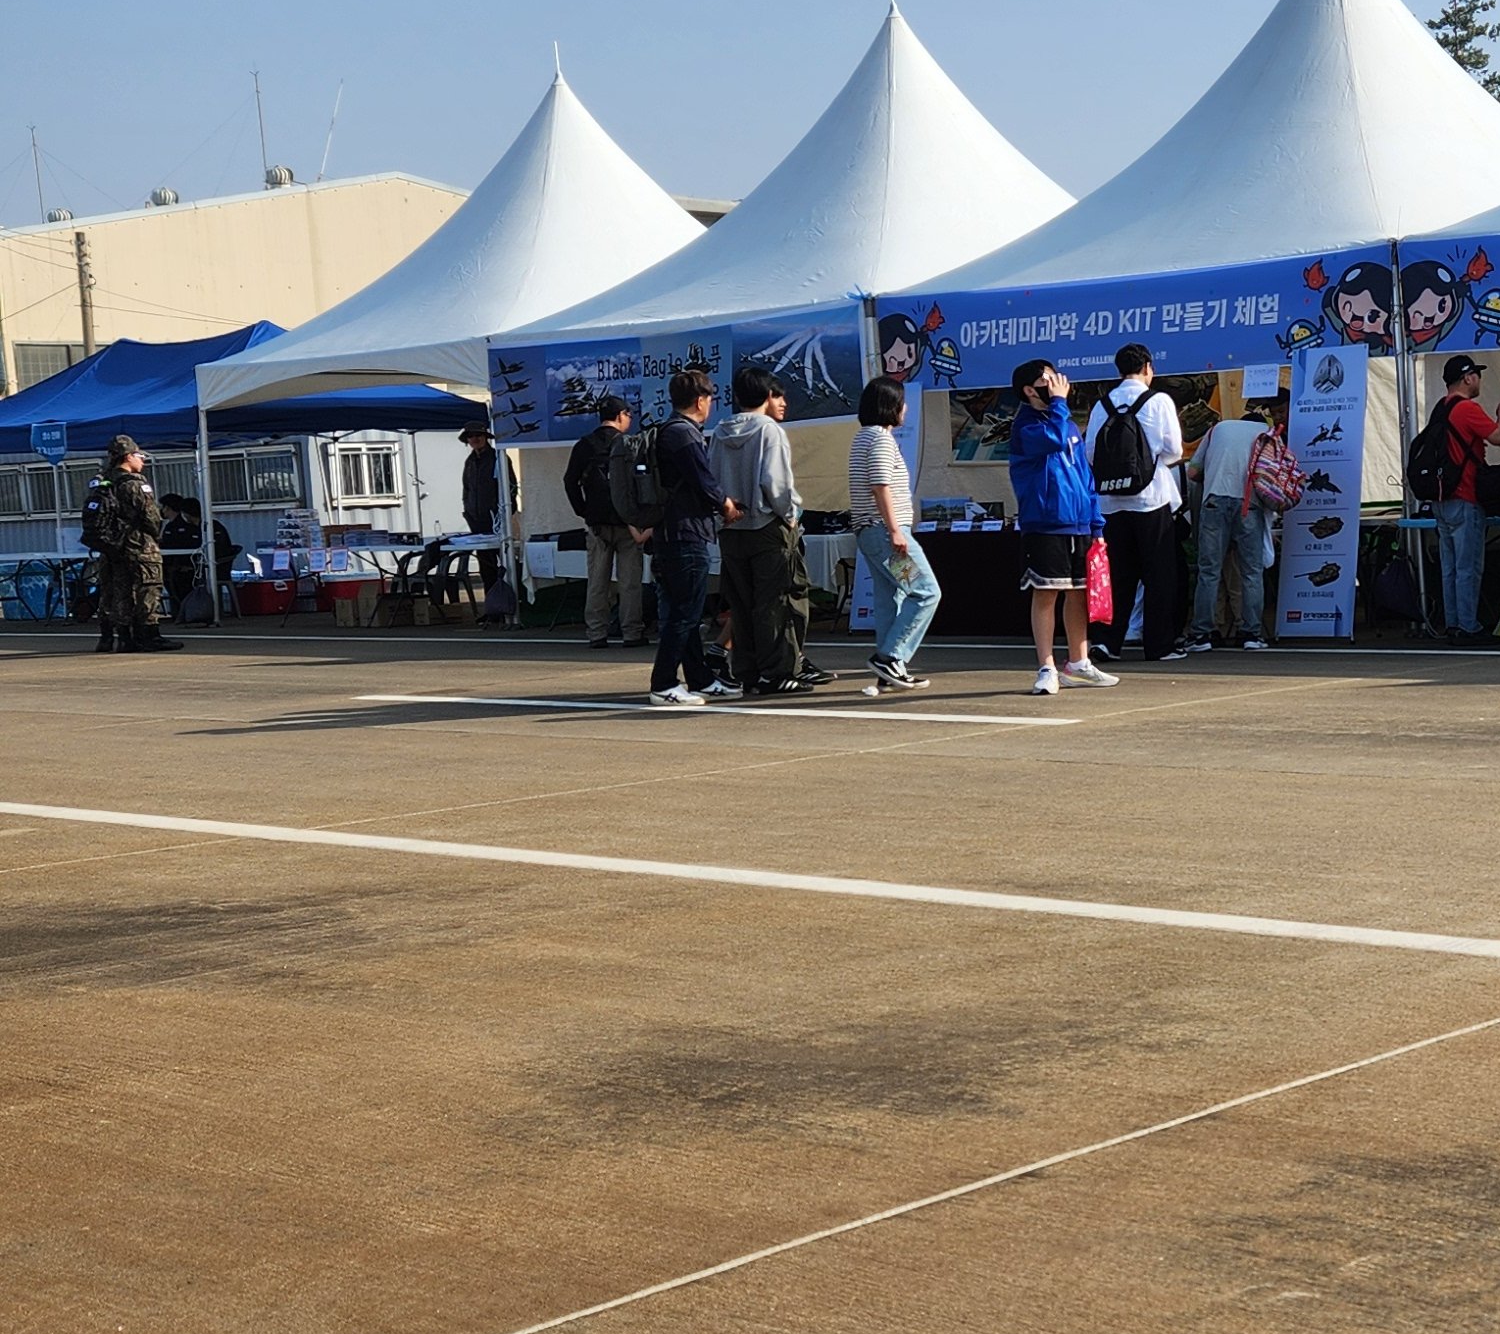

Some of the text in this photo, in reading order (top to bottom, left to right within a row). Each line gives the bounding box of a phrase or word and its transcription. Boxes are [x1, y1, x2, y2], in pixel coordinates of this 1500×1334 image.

[960, 293, 1280, 349] 아카데미과학 4D KIT 만들기 체험
[597, 358, 635, 382] Black
[1057, 356, 1080, 368] SPACE
[1100, 477, 1132, 492] MSGM
